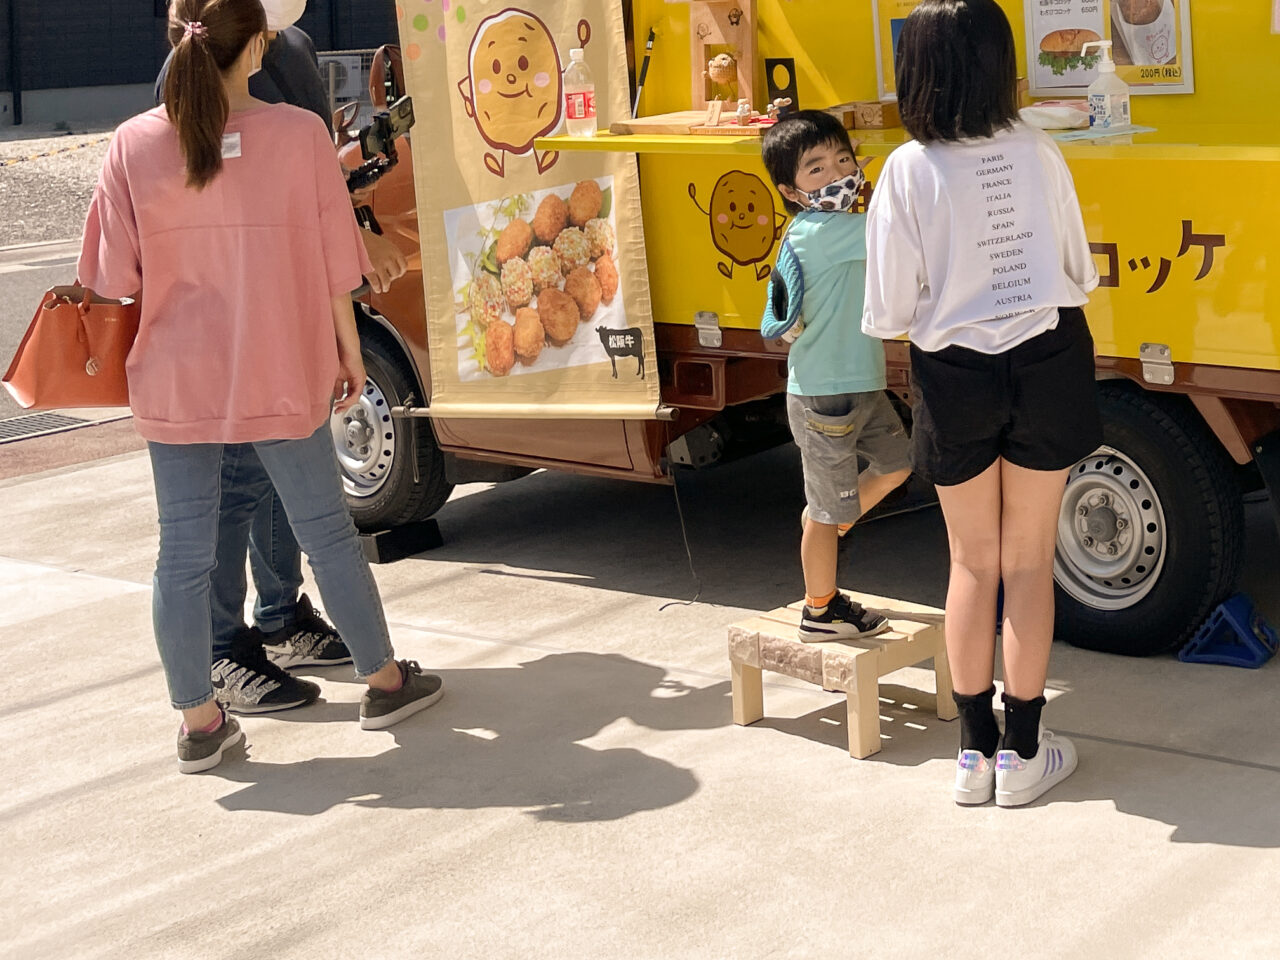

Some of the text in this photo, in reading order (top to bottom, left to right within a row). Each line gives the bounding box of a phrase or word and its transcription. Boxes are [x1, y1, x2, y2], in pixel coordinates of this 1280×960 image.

[981, 154, 1004, 164] PARIS
[976, 163, 1014, 176] GERMANY
[982, 178, 1012, 190] FRANCE
[986, 192, 1011, 202] ITALIA
[988, 206, 1015, 217] RUSSIA
[992, 221, 1015, 230] SPAIN
[977, 231, 1033, 248] SWITZERLAND
[989, 248, 1023, 260] SWEDEN
[992, 262, 1027, 275] POLAND
[992, 277, 1031, 291] BELGIUM
[994, 293, 1032, 306] AUSTRIA
[609, 334, 635, 348] 松阪牛
